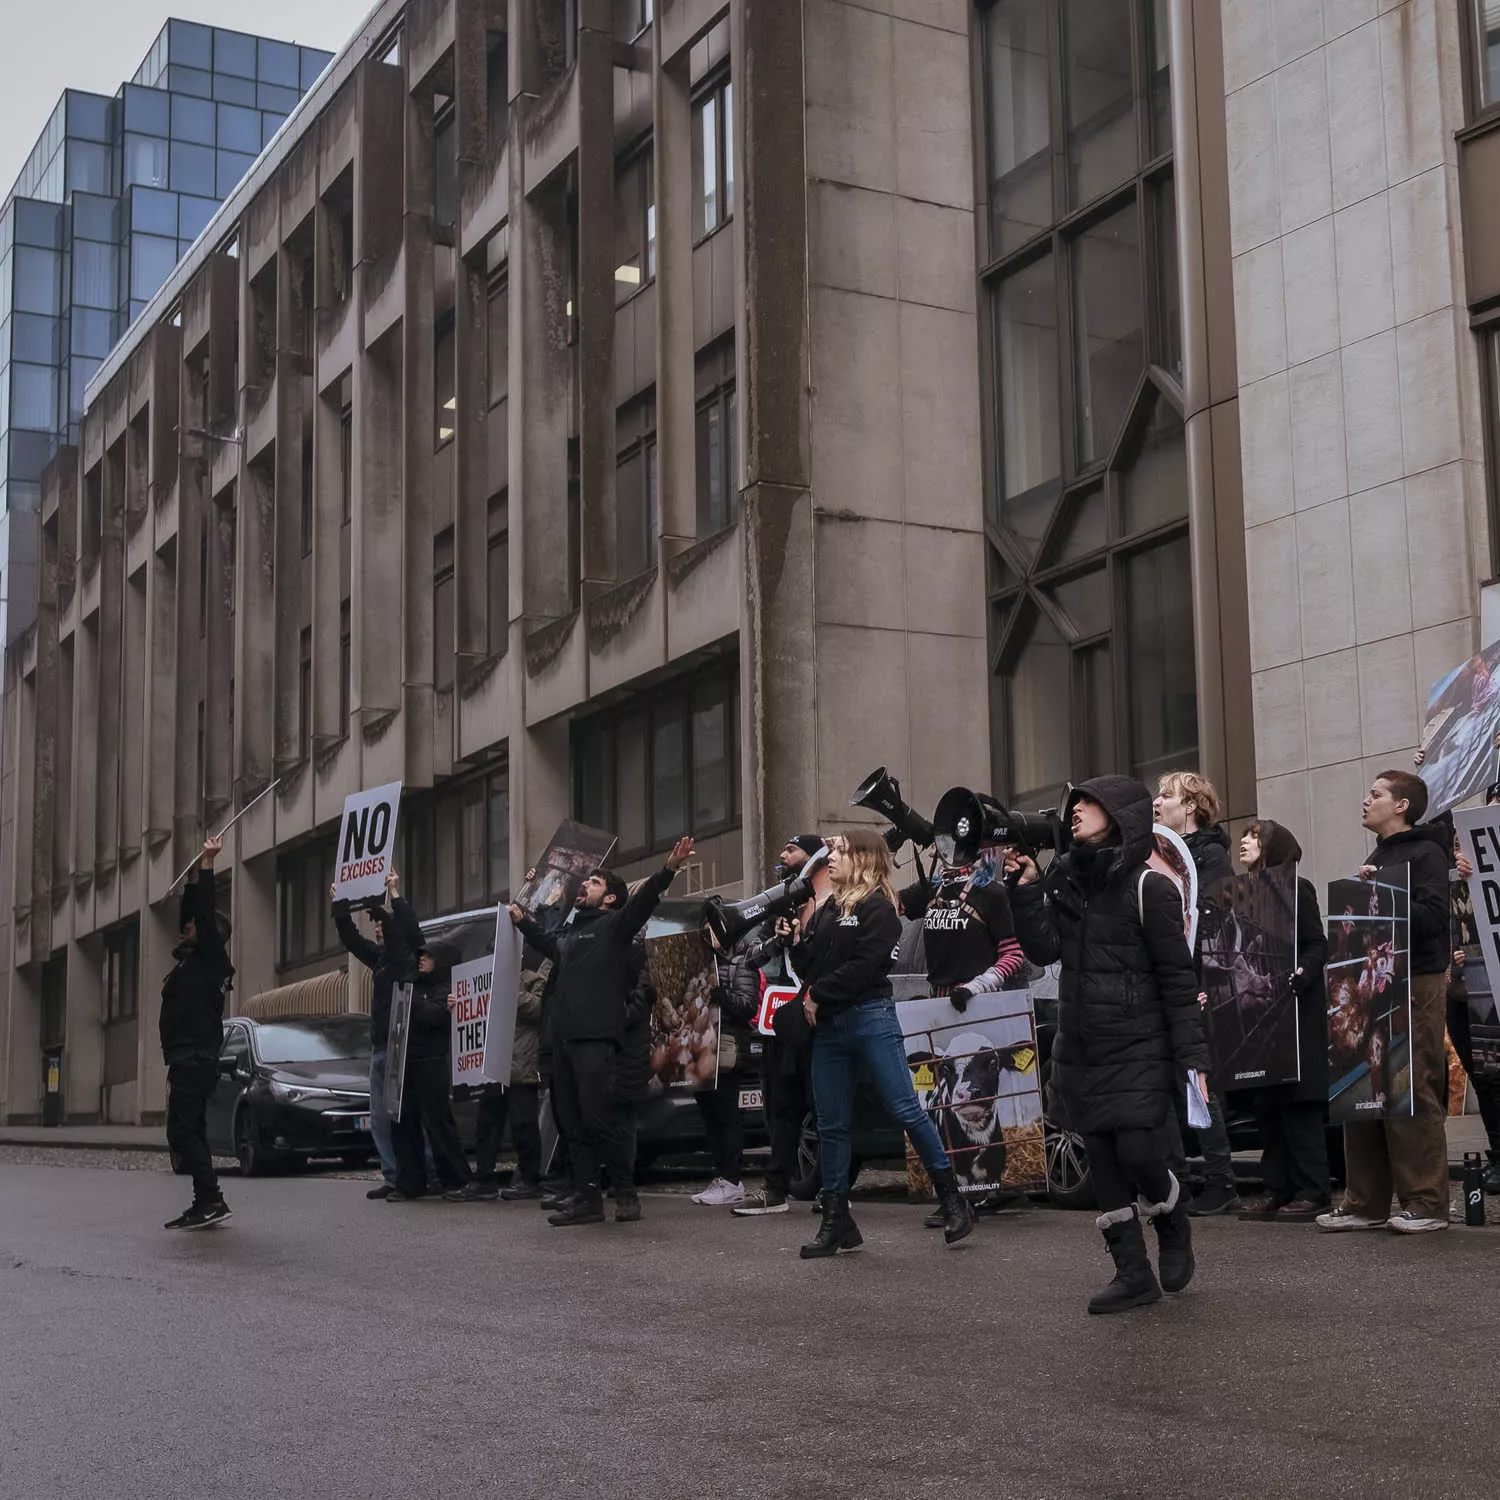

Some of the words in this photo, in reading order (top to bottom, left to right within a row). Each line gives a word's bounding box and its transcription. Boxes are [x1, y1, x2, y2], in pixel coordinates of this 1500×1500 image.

[343, 801, 391, 863] NO
[340, 856, 385, 883] EXCUSES
[925, 907, 961, 918] animal
[456, 979, 471, 998] EU:
